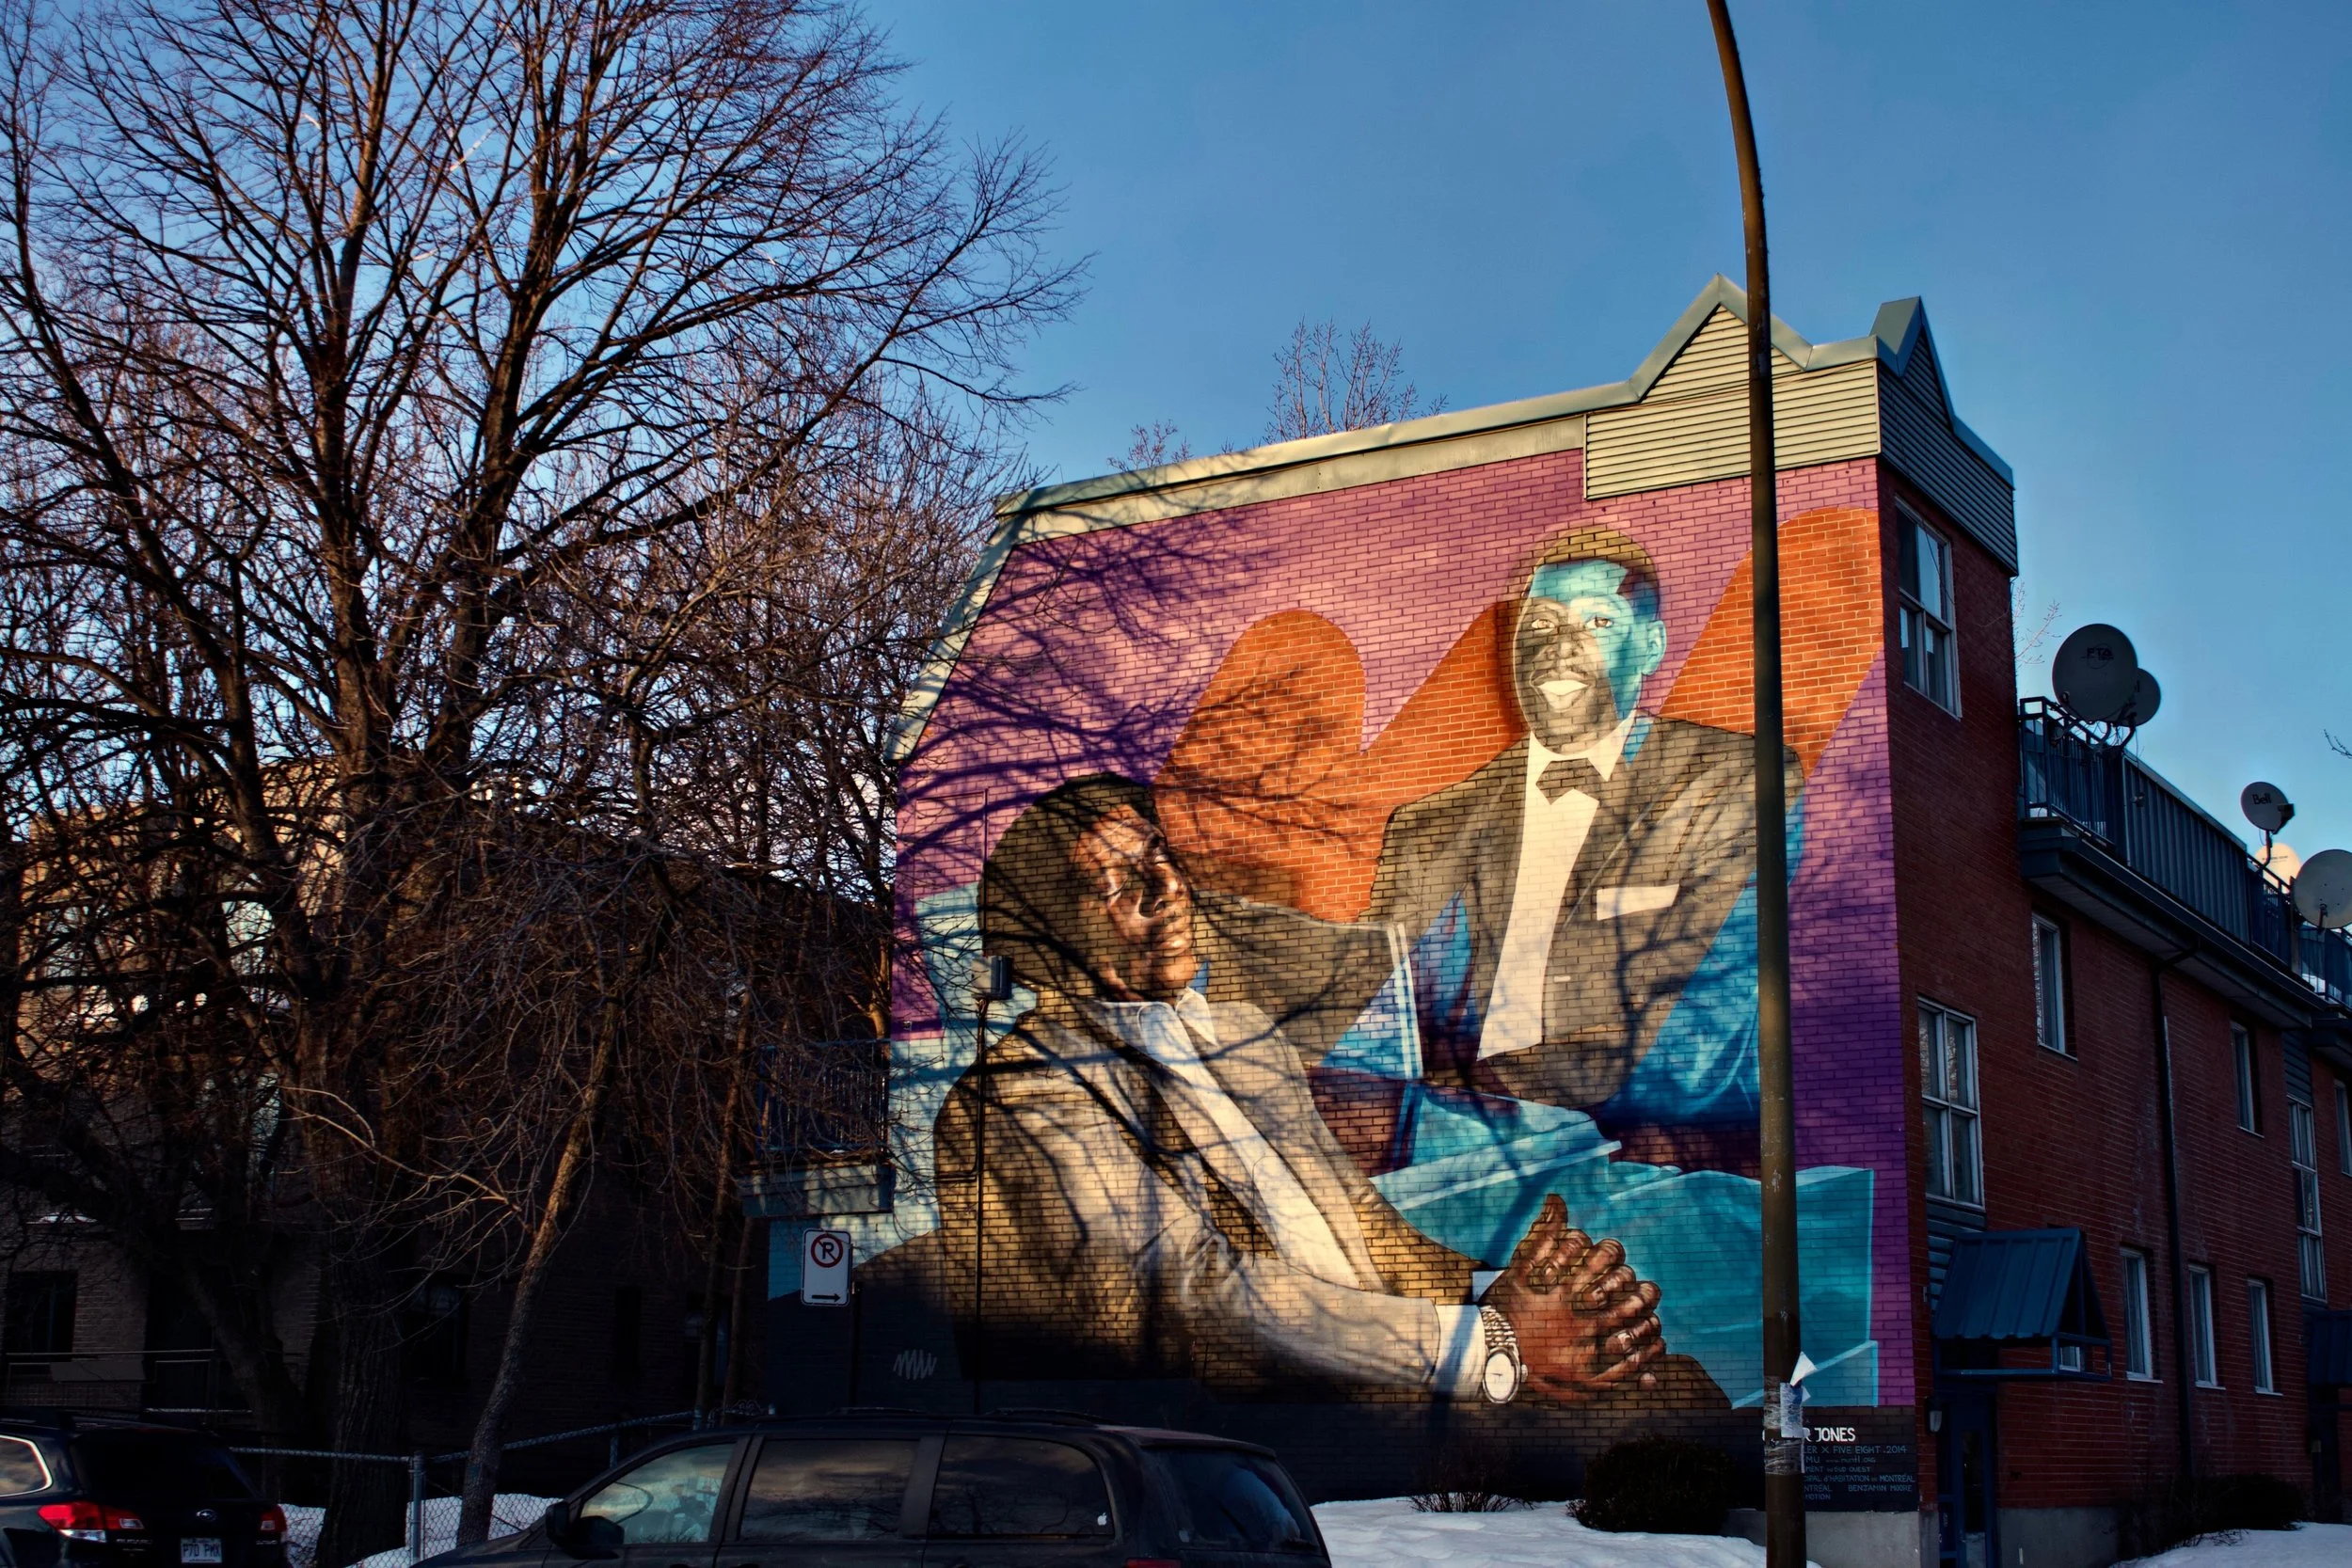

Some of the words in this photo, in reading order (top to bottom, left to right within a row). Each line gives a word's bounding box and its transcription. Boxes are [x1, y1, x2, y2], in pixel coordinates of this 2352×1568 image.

[2087, 647, 2112, 657] FTA
[2252, 794, 2272, 804] Bell
[1814, 1427, 1856, 1442] JONES
[1833, 1445, 1852, 1454] FIVE
[1854, 1445, 1881, 1454] EIGHT
[1848, 1484, 1887, 1493] BENJAMIN
[1890, 1484, 1913, 1493] MOORE
